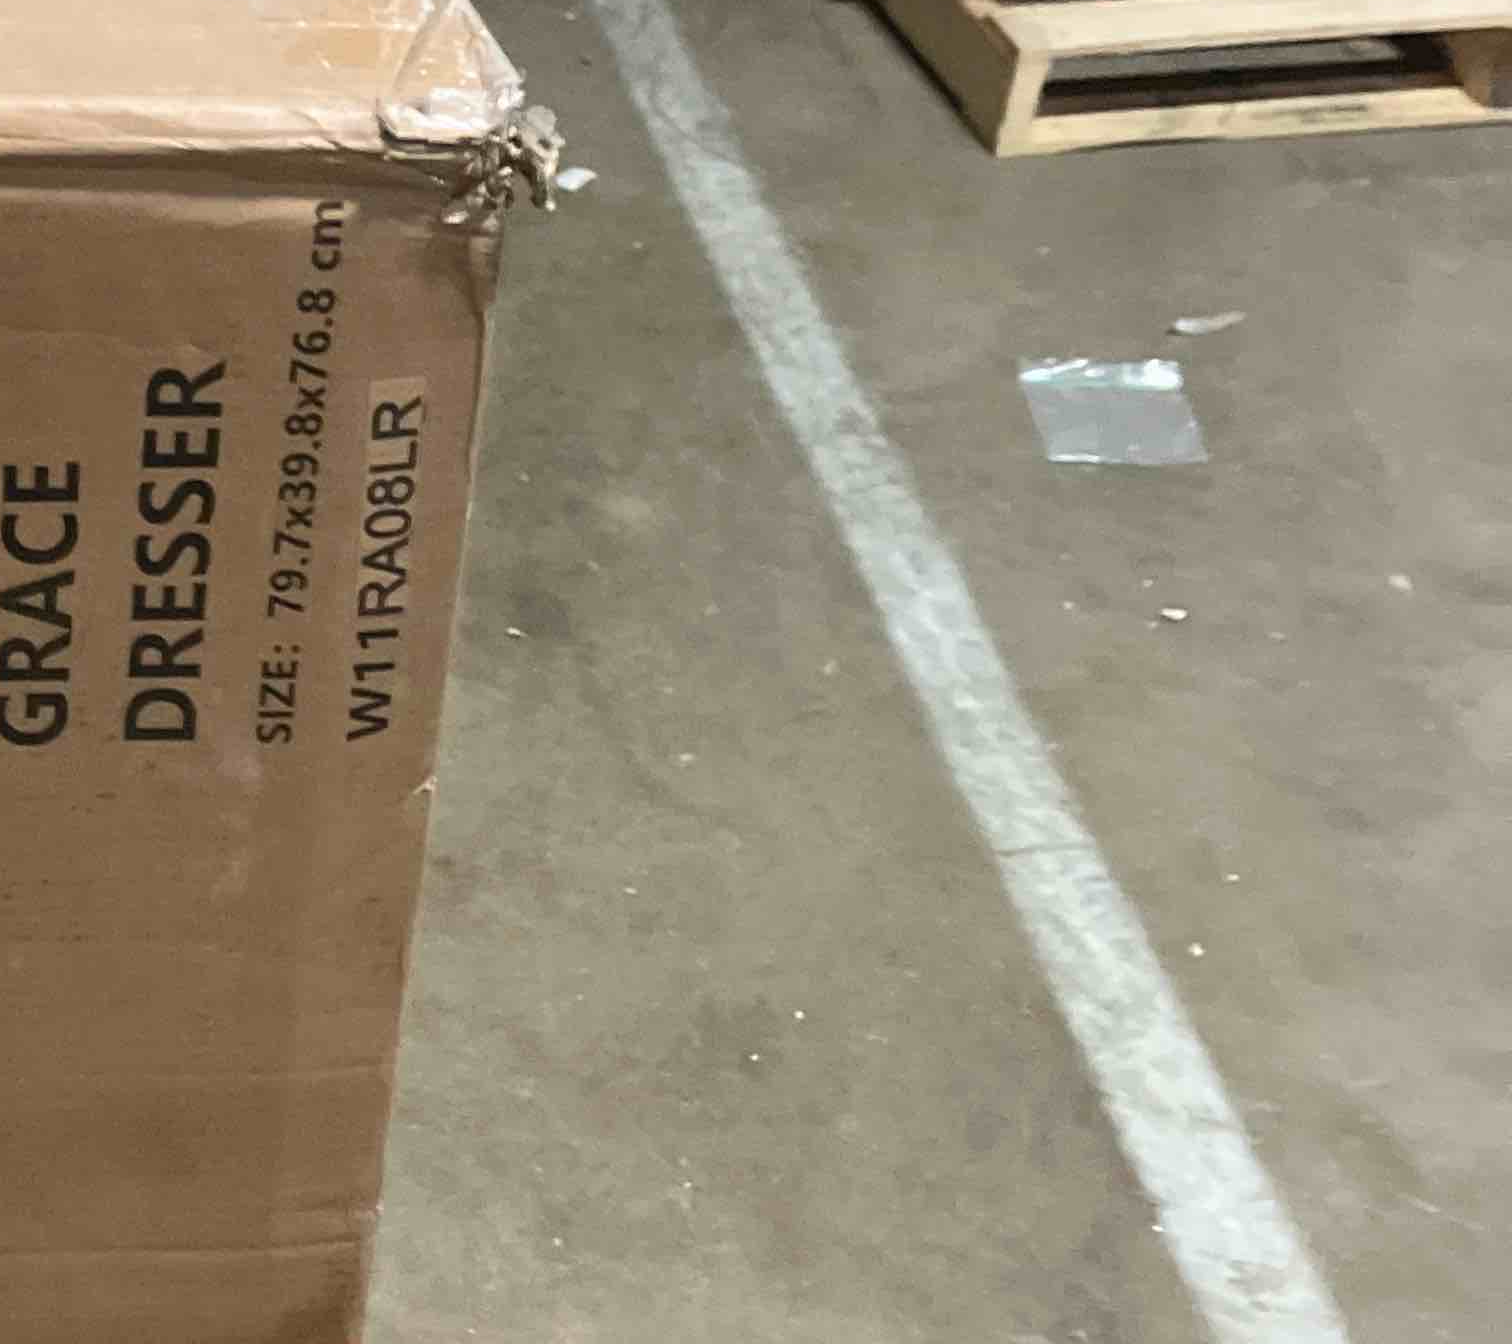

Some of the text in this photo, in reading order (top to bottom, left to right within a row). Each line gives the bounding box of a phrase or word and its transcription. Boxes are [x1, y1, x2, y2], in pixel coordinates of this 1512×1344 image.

[123, 359, 228, 742] DRESSER
[255, 200, 345, 745] SIZE: 79.7x39.8x76.8 cm
[345, 394, 423, 743] W11RA08LR
